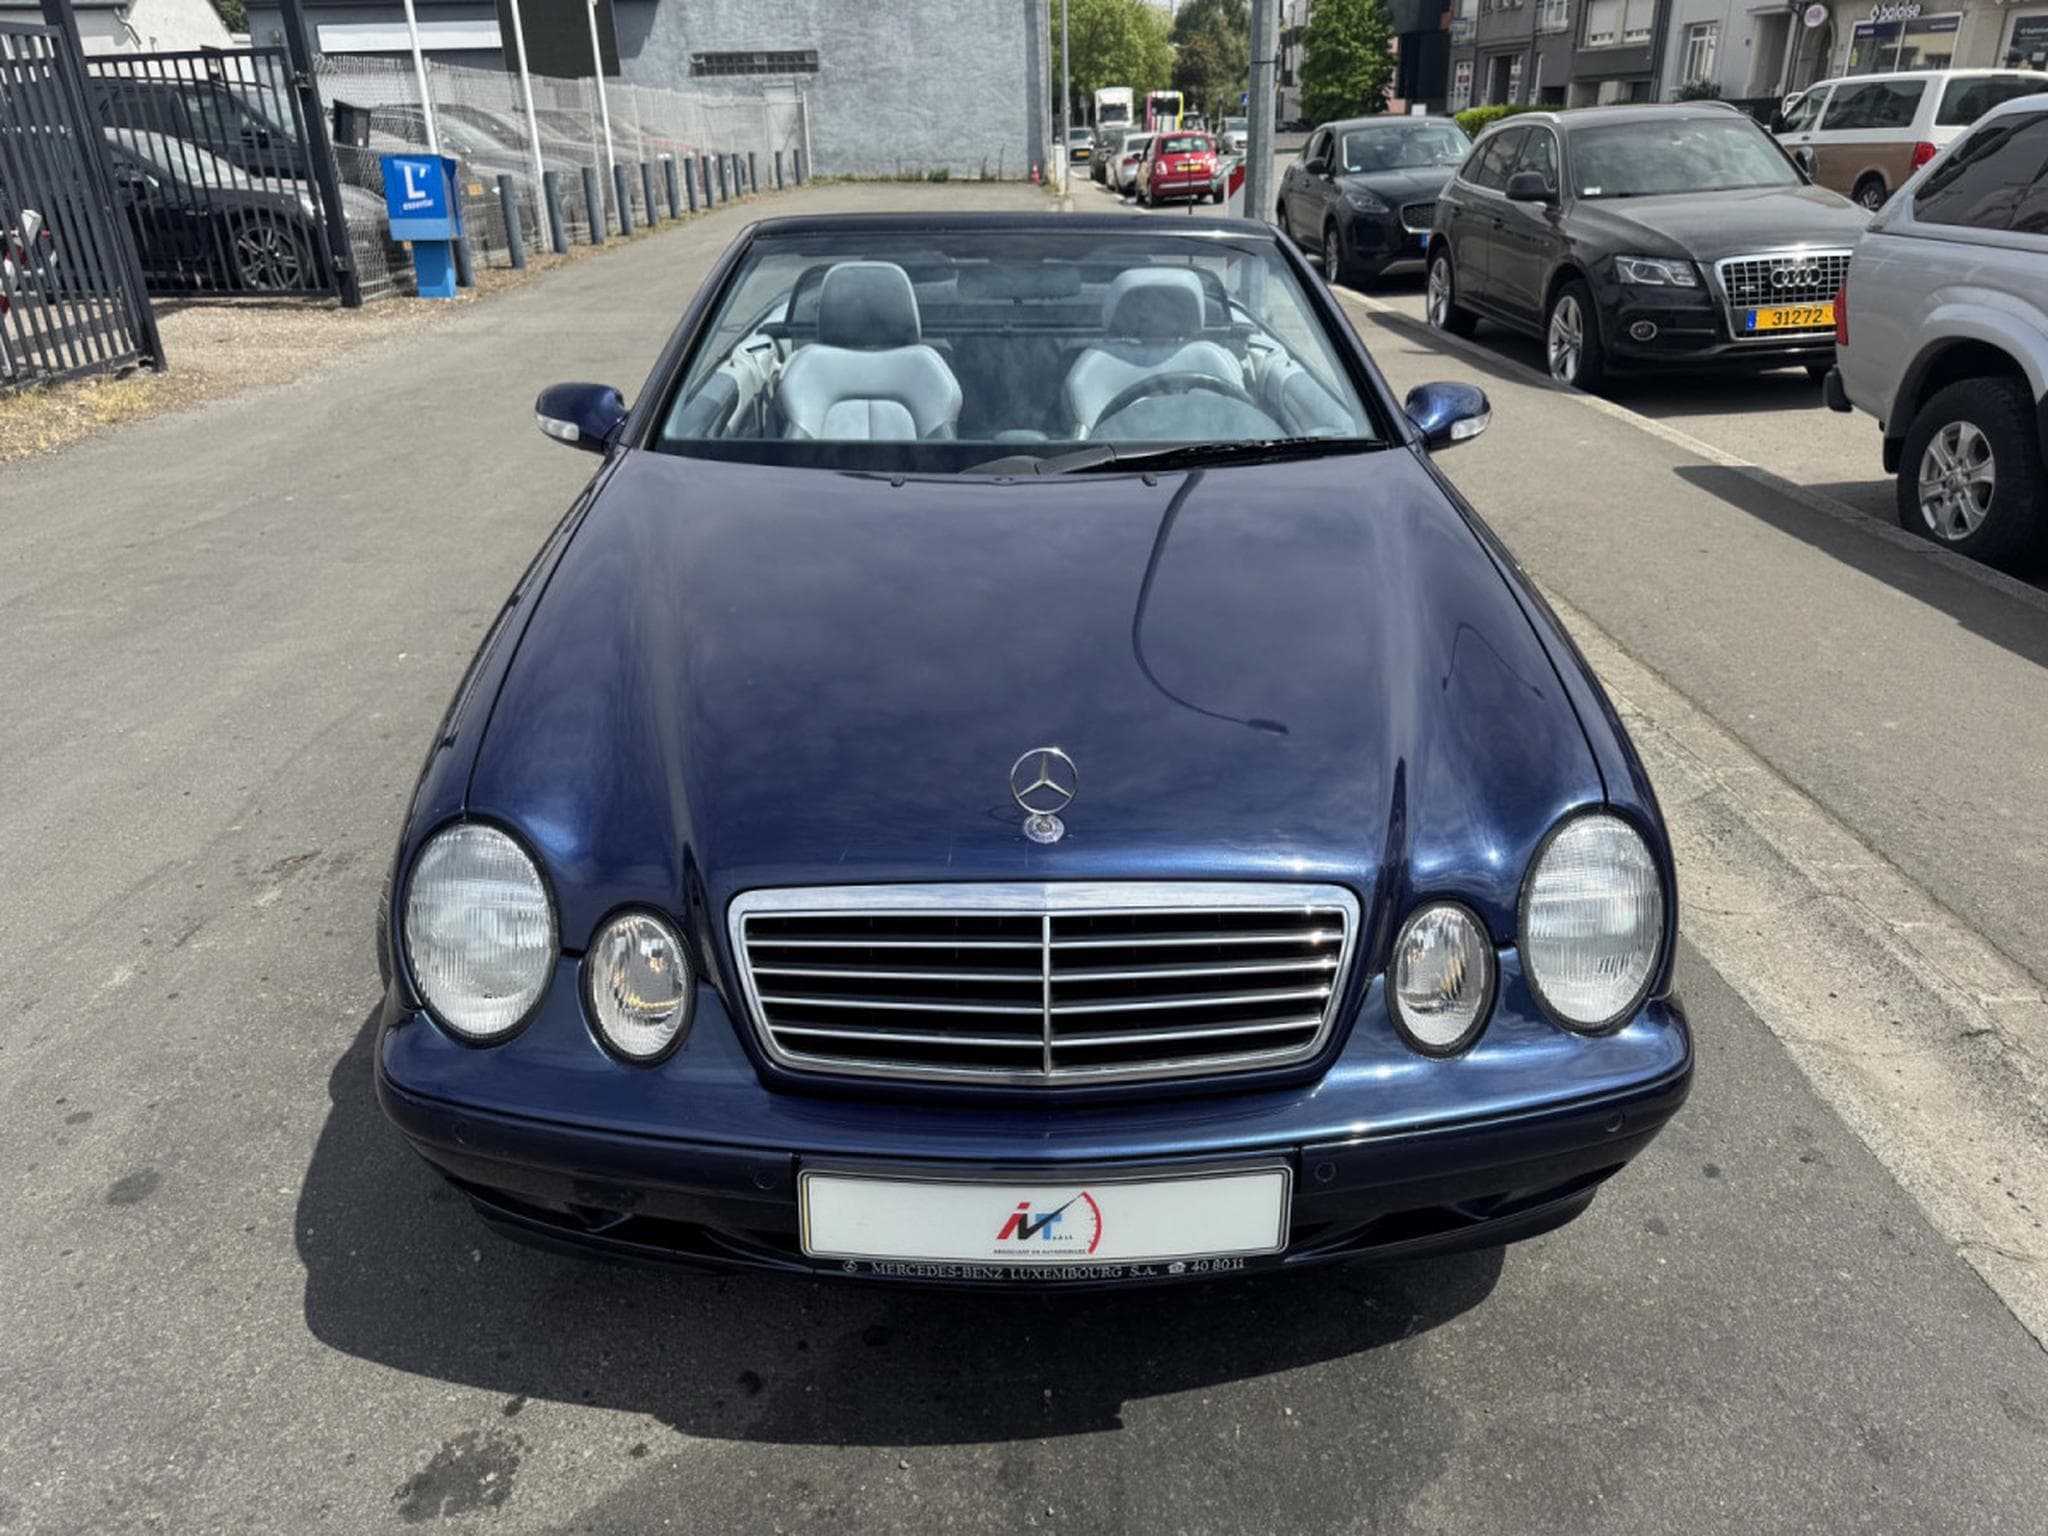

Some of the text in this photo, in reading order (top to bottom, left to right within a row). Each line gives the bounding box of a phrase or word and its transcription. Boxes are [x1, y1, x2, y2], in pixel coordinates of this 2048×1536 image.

[1880, 0, 1921, 21] baloise
[1771, 308, 1825, 327] 31272
[871, 1262, 1004, 1280] MERCEDES-BENZ
[1010, 1265, 1123, 1280] LUXEMBOURG
[1129, 1264, 1158, 1277] S.A.
[1190, 1260, 1209, 1272] 40
